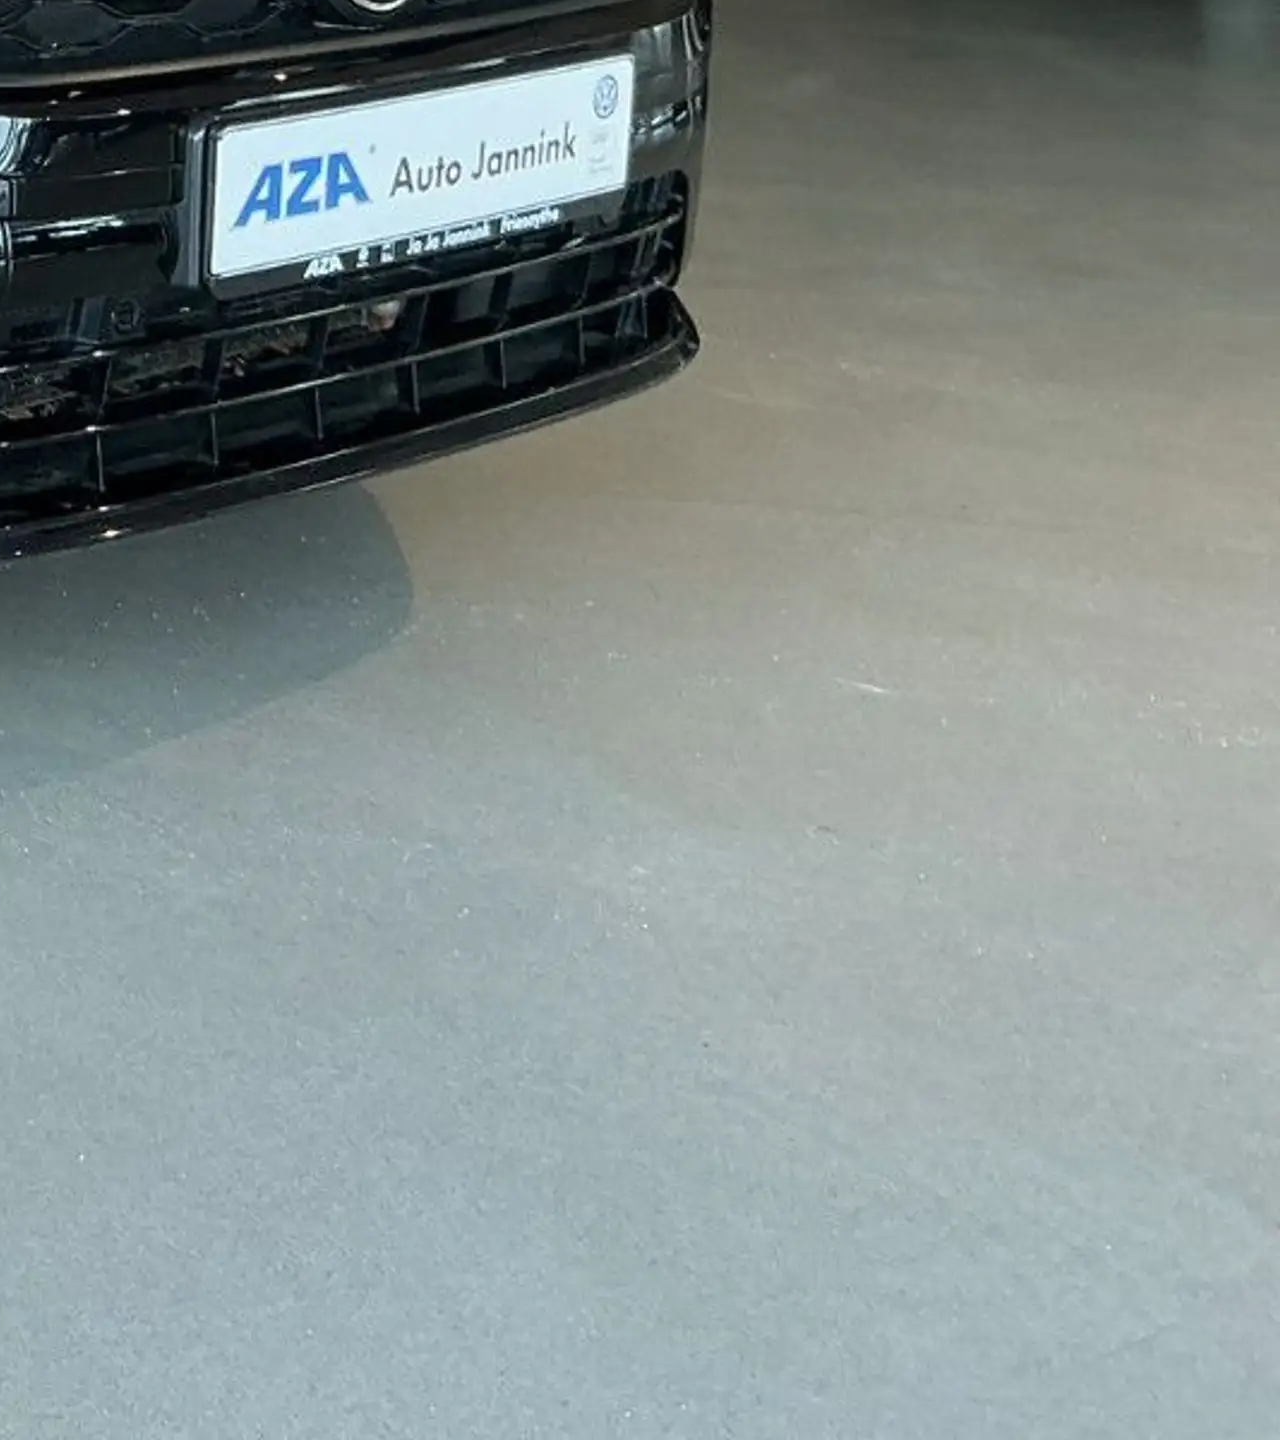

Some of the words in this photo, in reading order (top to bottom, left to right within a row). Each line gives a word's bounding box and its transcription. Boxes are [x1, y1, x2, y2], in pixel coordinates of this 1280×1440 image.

[230, 151, 372, 231] AZA
[389, 156, 462, 197] Auto
[470, 121, 577, 180] Jannink
[303, 254, 345, 280] AZA
